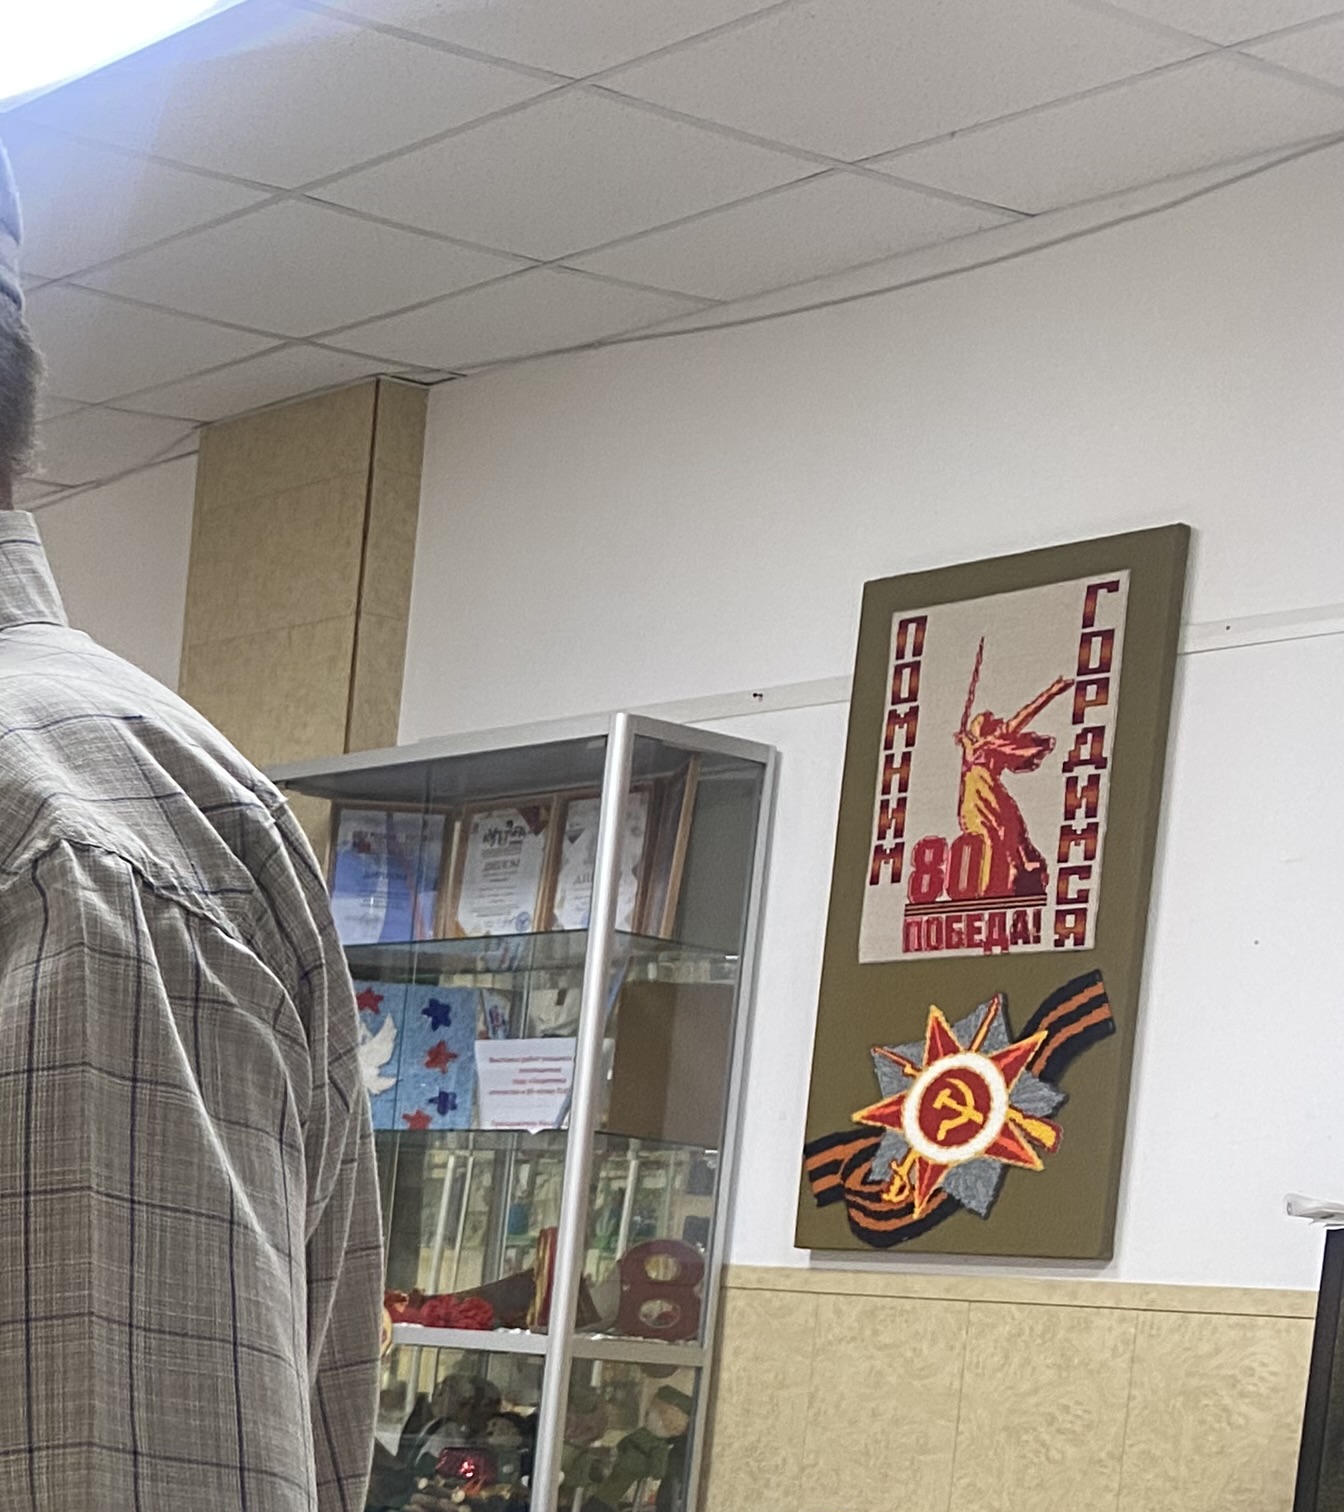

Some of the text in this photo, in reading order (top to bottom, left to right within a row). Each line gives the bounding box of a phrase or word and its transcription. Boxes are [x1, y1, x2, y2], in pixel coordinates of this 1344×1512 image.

[870, 615, 928, 886] ПОМНИМ
[1054, 580, 1120, 947] ГОРДИМСЯ
[903, 909, 1042, 955] ПОБЕДА!
[908, 834, 986, 903] 80
